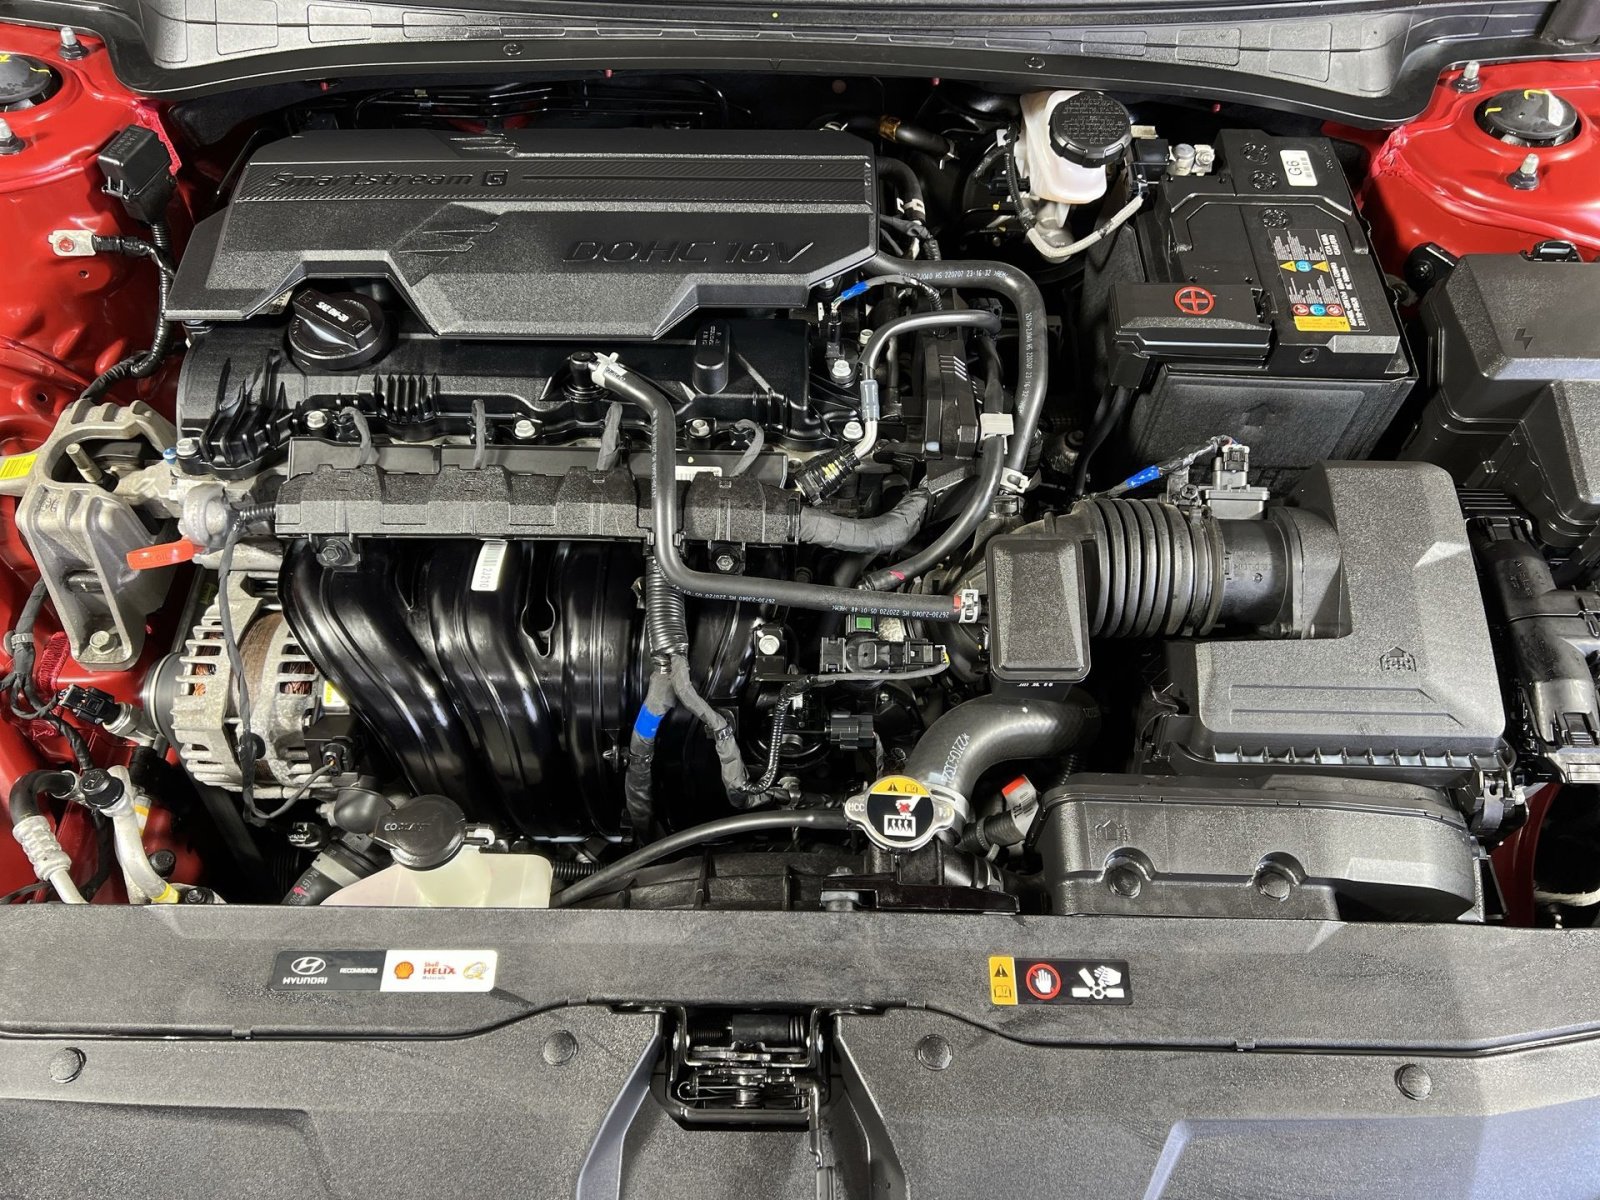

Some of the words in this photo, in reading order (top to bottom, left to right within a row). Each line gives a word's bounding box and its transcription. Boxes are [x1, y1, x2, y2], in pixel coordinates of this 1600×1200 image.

[1288, 160, 1303, 177] G6
[269, 171, 474, 188] Smartstream
[562, 240, 717, 264] DOHC
[724, 240, 815, 264] 16V
[423, 966, 456, 975] HELIX
[282, 976, 328, 985] HYUNDAI
